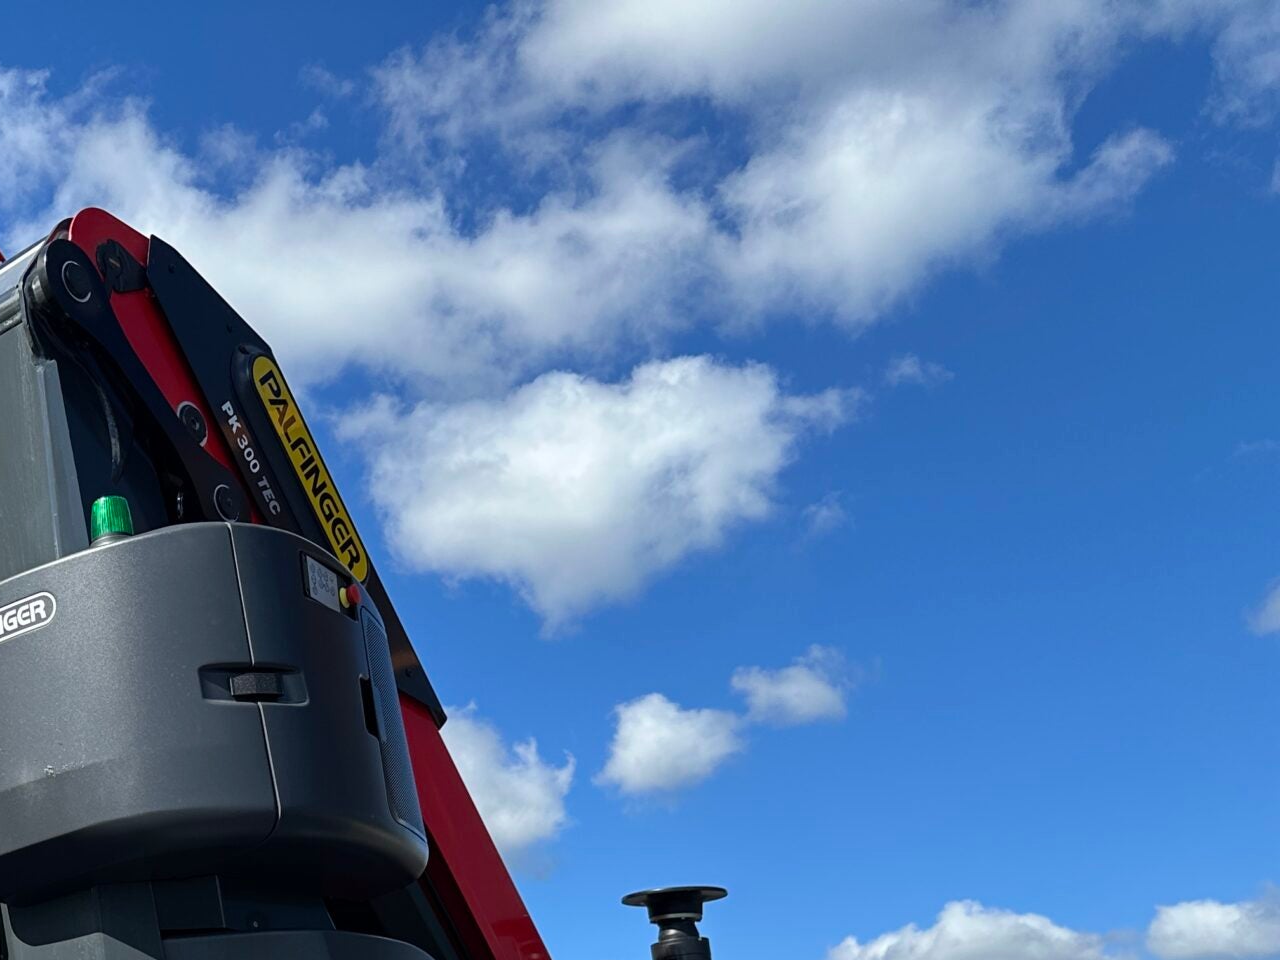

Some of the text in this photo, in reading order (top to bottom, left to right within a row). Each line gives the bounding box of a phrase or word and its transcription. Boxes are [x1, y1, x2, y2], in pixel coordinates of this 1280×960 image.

[221, 400, 281, 516] PK 300 TEC
[258, 369, 361, 572] PALFINGER
